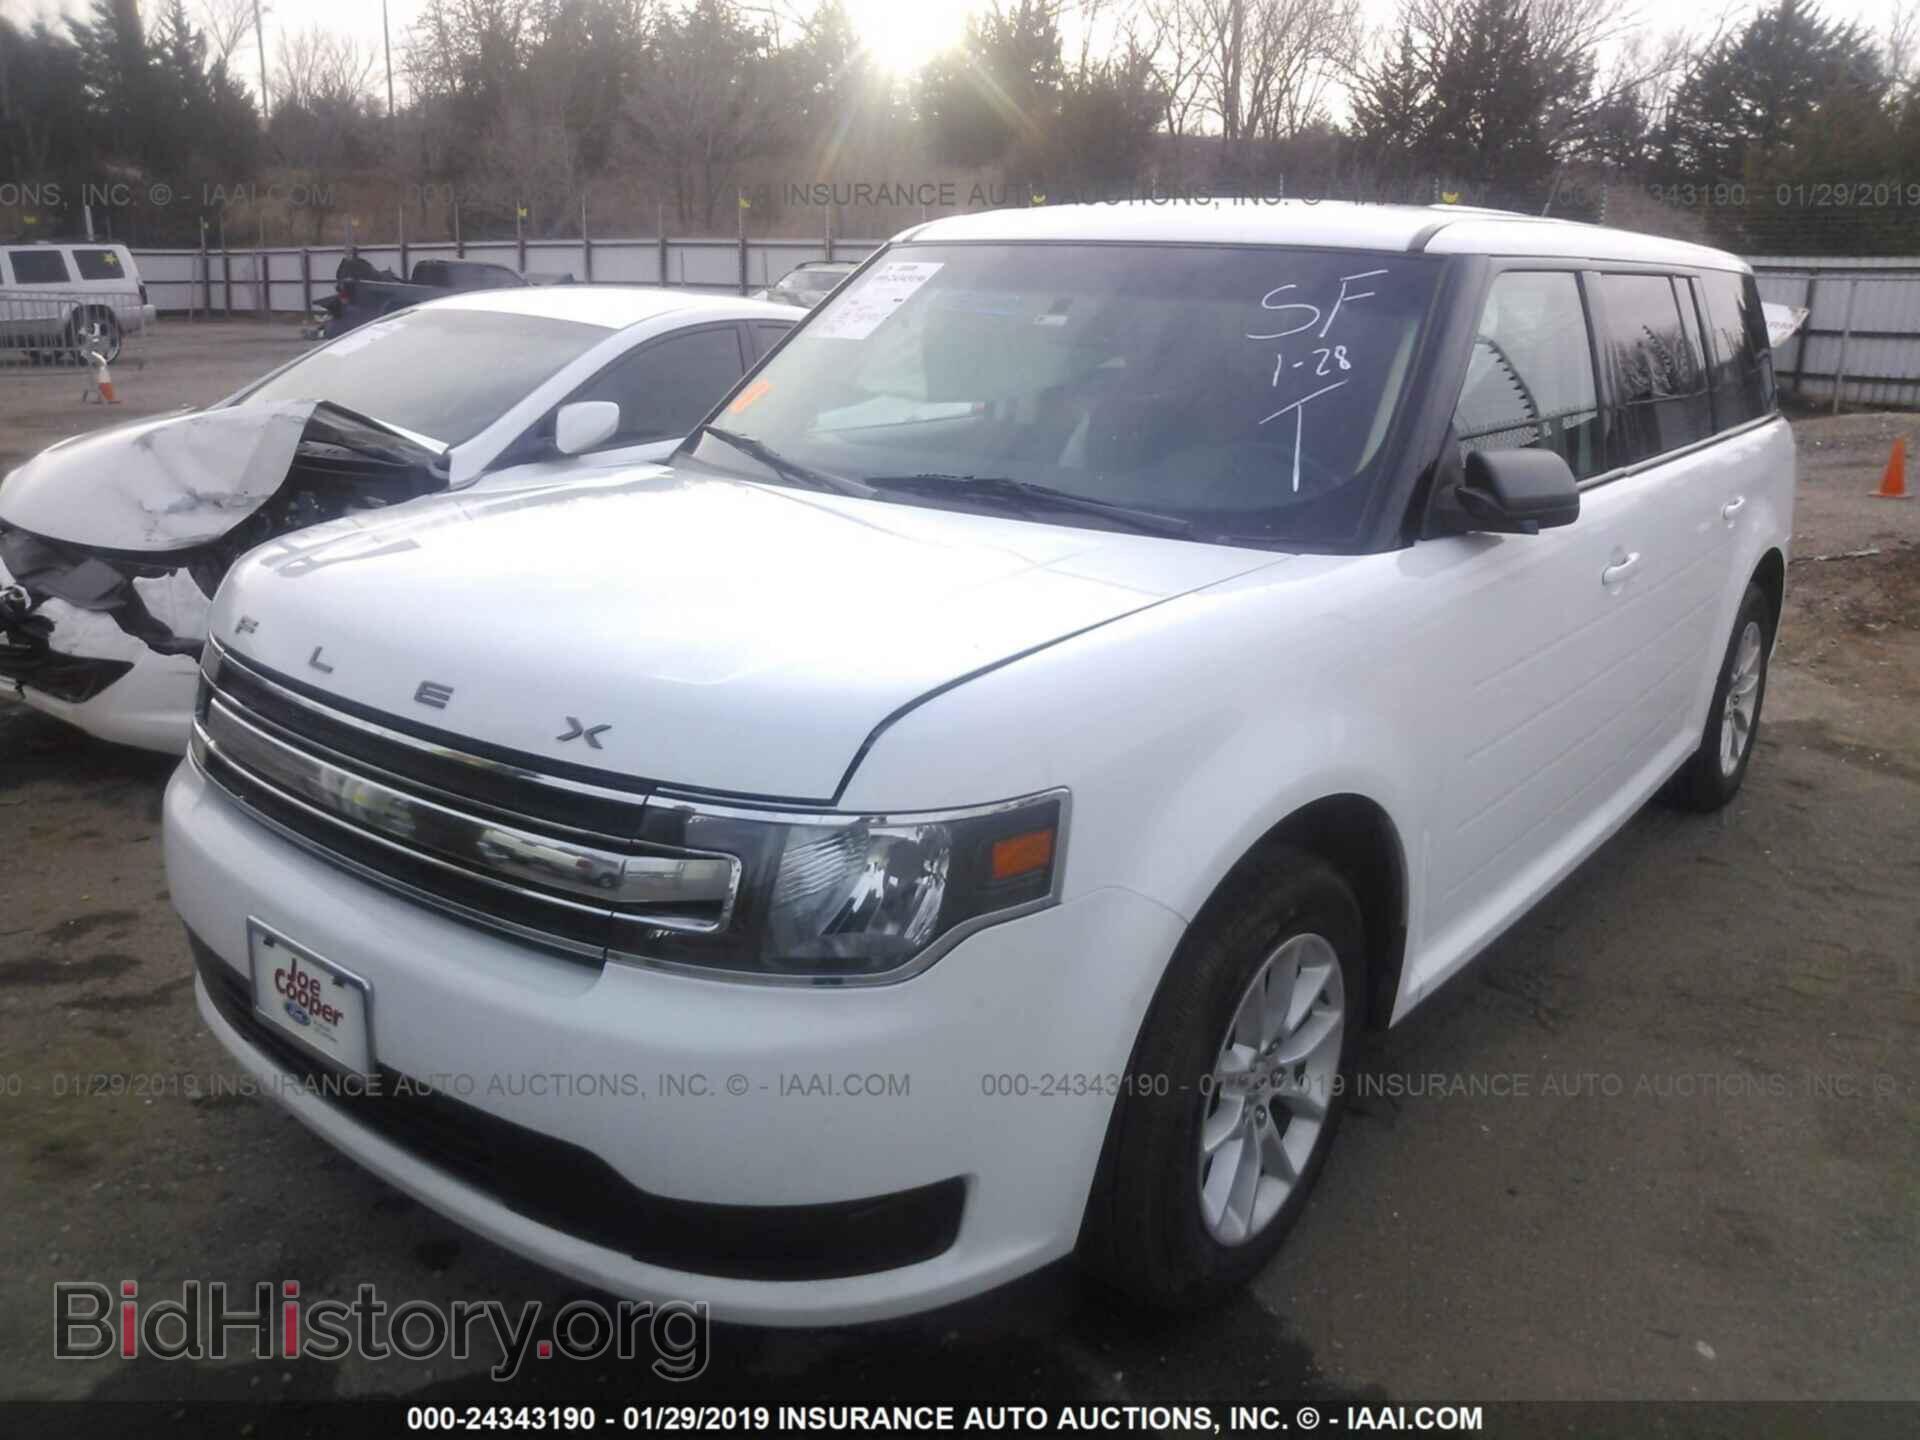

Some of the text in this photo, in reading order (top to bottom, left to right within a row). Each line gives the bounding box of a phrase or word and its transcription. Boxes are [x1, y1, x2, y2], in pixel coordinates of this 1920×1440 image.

[1272, 345, 1351, 387] 1-28
[235, 615, 613, 750] FLEX
[274, 968, 344, 1026] Cooper
[287, 957, 321, 996] Joe
